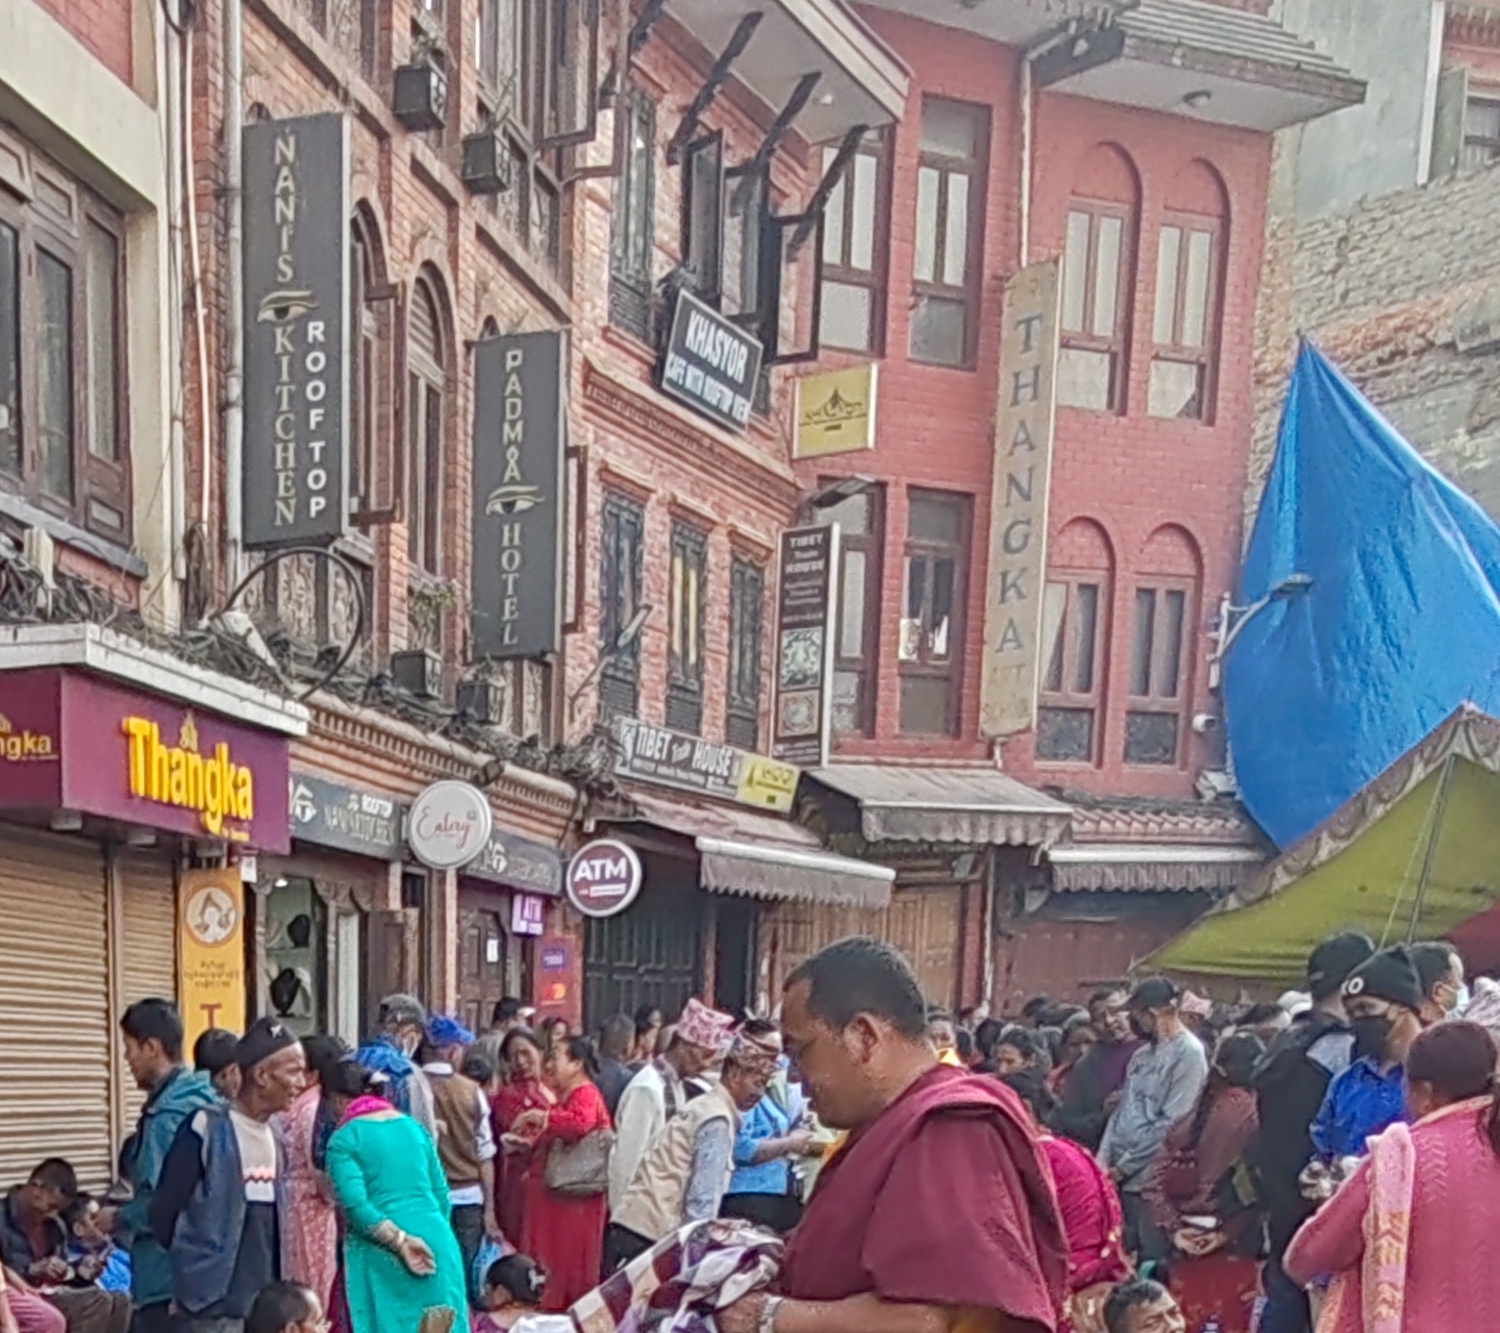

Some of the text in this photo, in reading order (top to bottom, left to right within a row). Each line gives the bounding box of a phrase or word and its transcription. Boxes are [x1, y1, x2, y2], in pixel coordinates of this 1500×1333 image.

[685, 309, 748, 385] KHASYOR
[273, 326, 297, 526] KITCHEN
[994, 312, 1044, 654] THANGKA
[501, 522, 521, 645] HOTEL
[122, 716, 254, 835] Thangka
[574, 856, 627, 883] ATM
